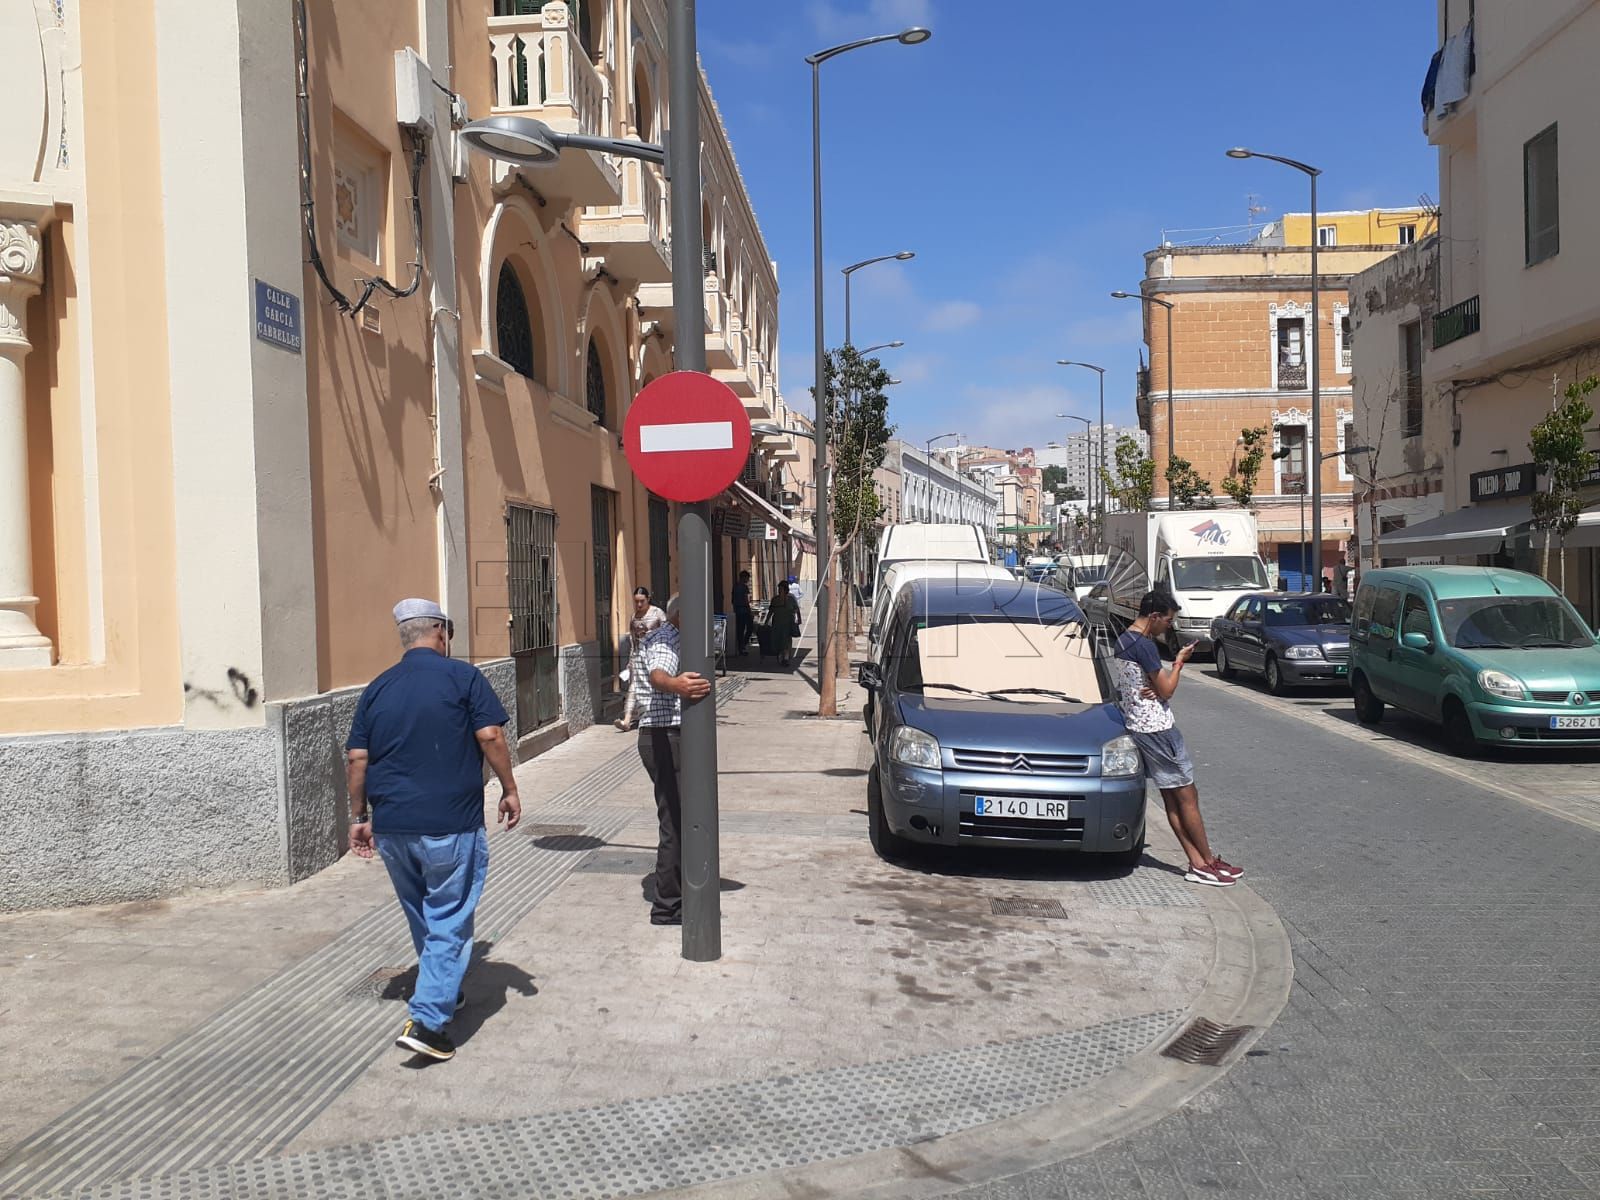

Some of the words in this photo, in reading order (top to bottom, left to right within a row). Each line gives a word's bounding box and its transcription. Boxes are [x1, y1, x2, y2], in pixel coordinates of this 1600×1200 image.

[266, 288, 291, 309] CALLE
[265, 306, 294, 328] GARCIA
[257, 321, 301, 348] CABRELLES
[1478, 474, 1499, 496] TOLEDO
[1505, 471, 1521, 491] SHOP
[1559, 718, 1587, 728] 5262
[984, 799, 1028, 815] 2140
[1036, 801, 1065, 817] LRR
